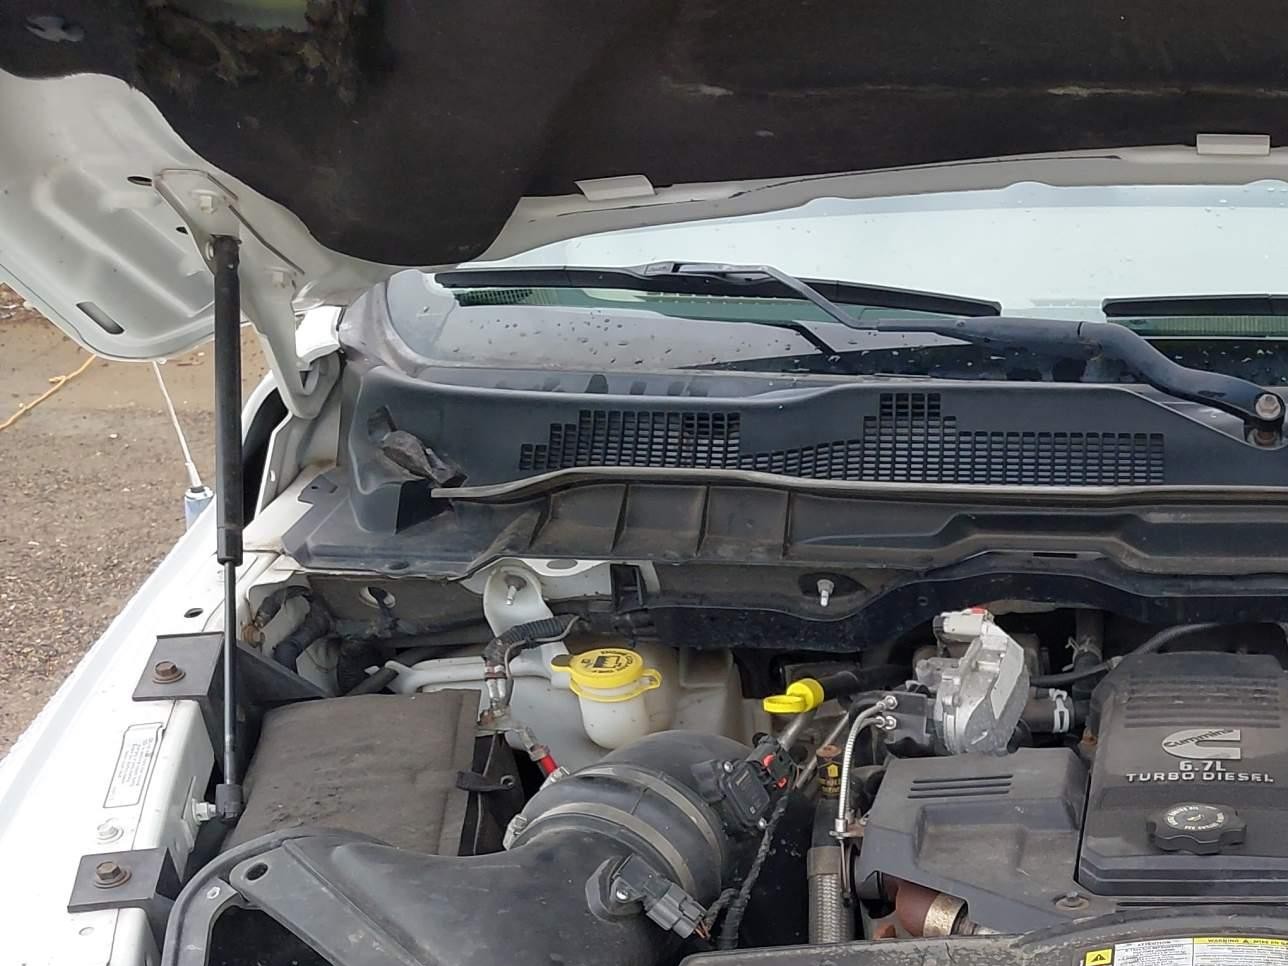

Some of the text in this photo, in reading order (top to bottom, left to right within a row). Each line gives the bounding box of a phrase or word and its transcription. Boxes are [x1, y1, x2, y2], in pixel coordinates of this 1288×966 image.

[1163, 728, 1235, 748] Cummins
[1179, 760, 1227, 772] 6.7L
[1126, 771, 1275, 784] TURBO DIESEL
